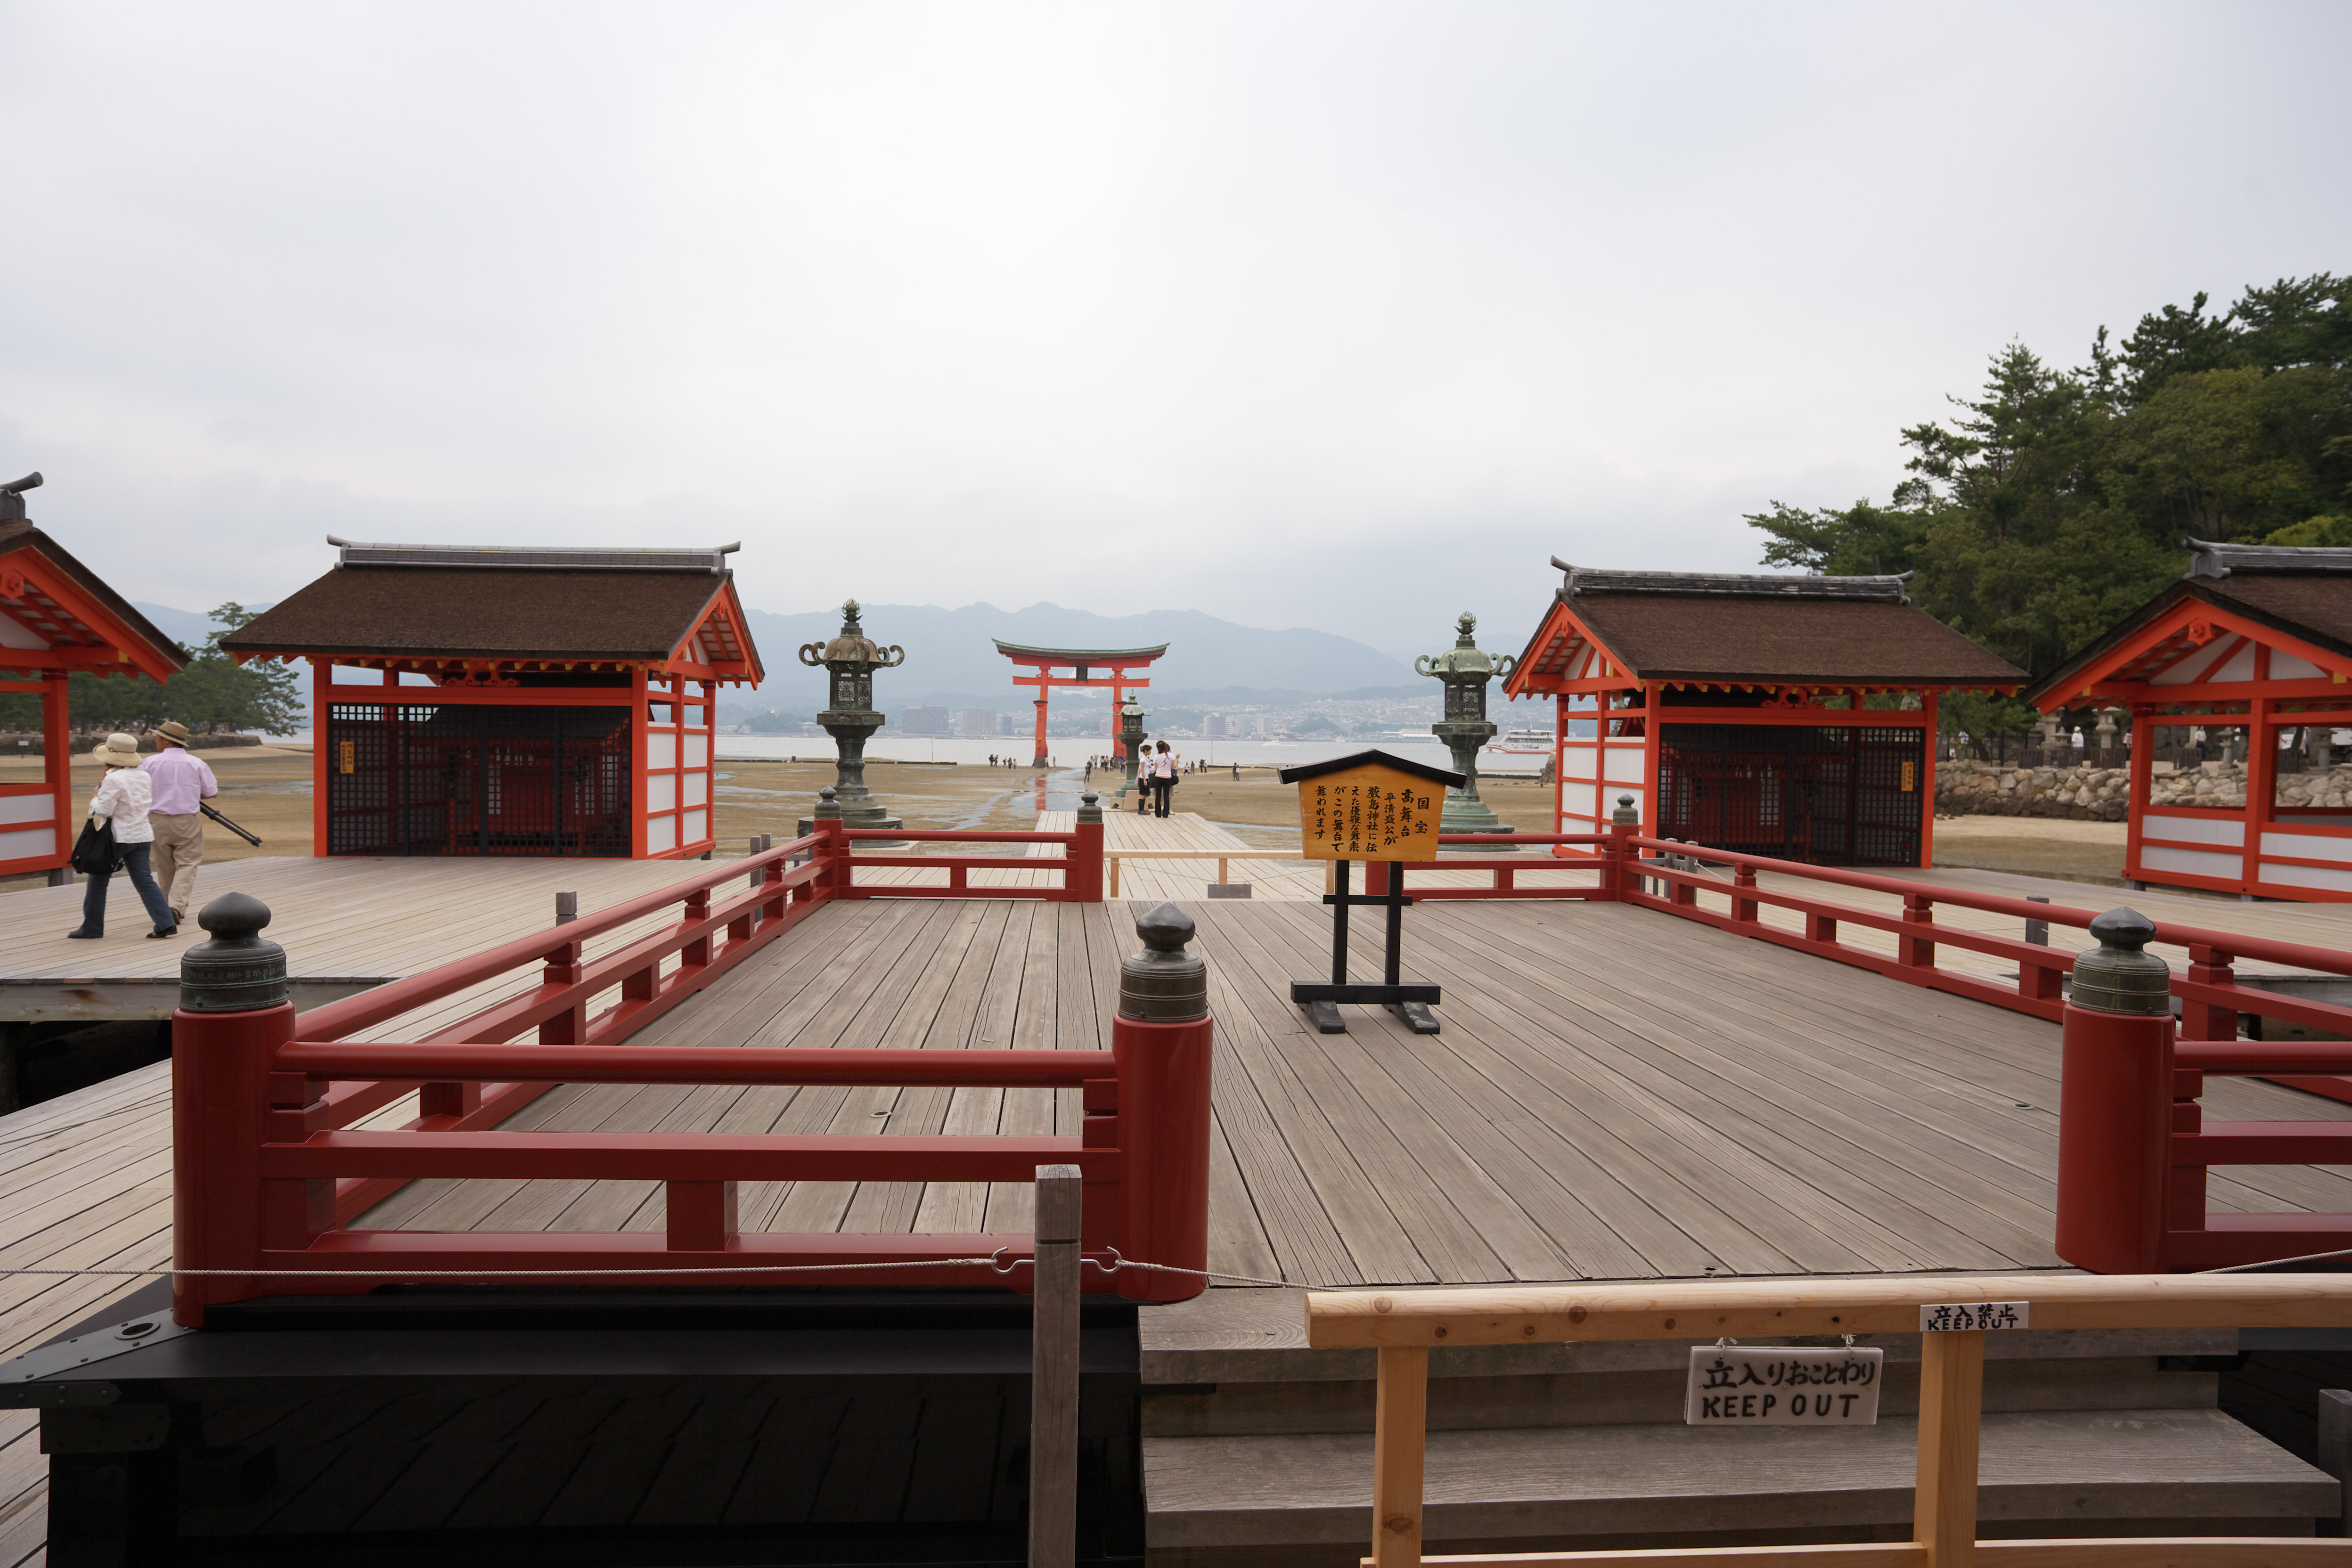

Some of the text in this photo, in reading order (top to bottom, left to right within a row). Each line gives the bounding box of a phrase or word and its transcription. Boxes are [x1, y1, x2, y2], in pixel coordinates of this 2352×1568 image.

[1315, 785, 1327, 840] 舞われます
[1331, 786, 1347, 852] がこの舞台で
[1348, 786, 1361, 852] えた優雅な舞楽
[1365, 786, 1380, 852] 厳島神社に伝
[1384, 792, 1398, 845] 平清盛公が
[1415, 797, 1429, 833] 国宝
[1927, 1317, 2018, 1331] KEEP OUT
[1935, 1303, 2014, 1319] 立入禁止
[1702, 1360, 1875, 1389] 立入りおことわり
[1702, 1394, 1859, 1419] KEEP OUT
